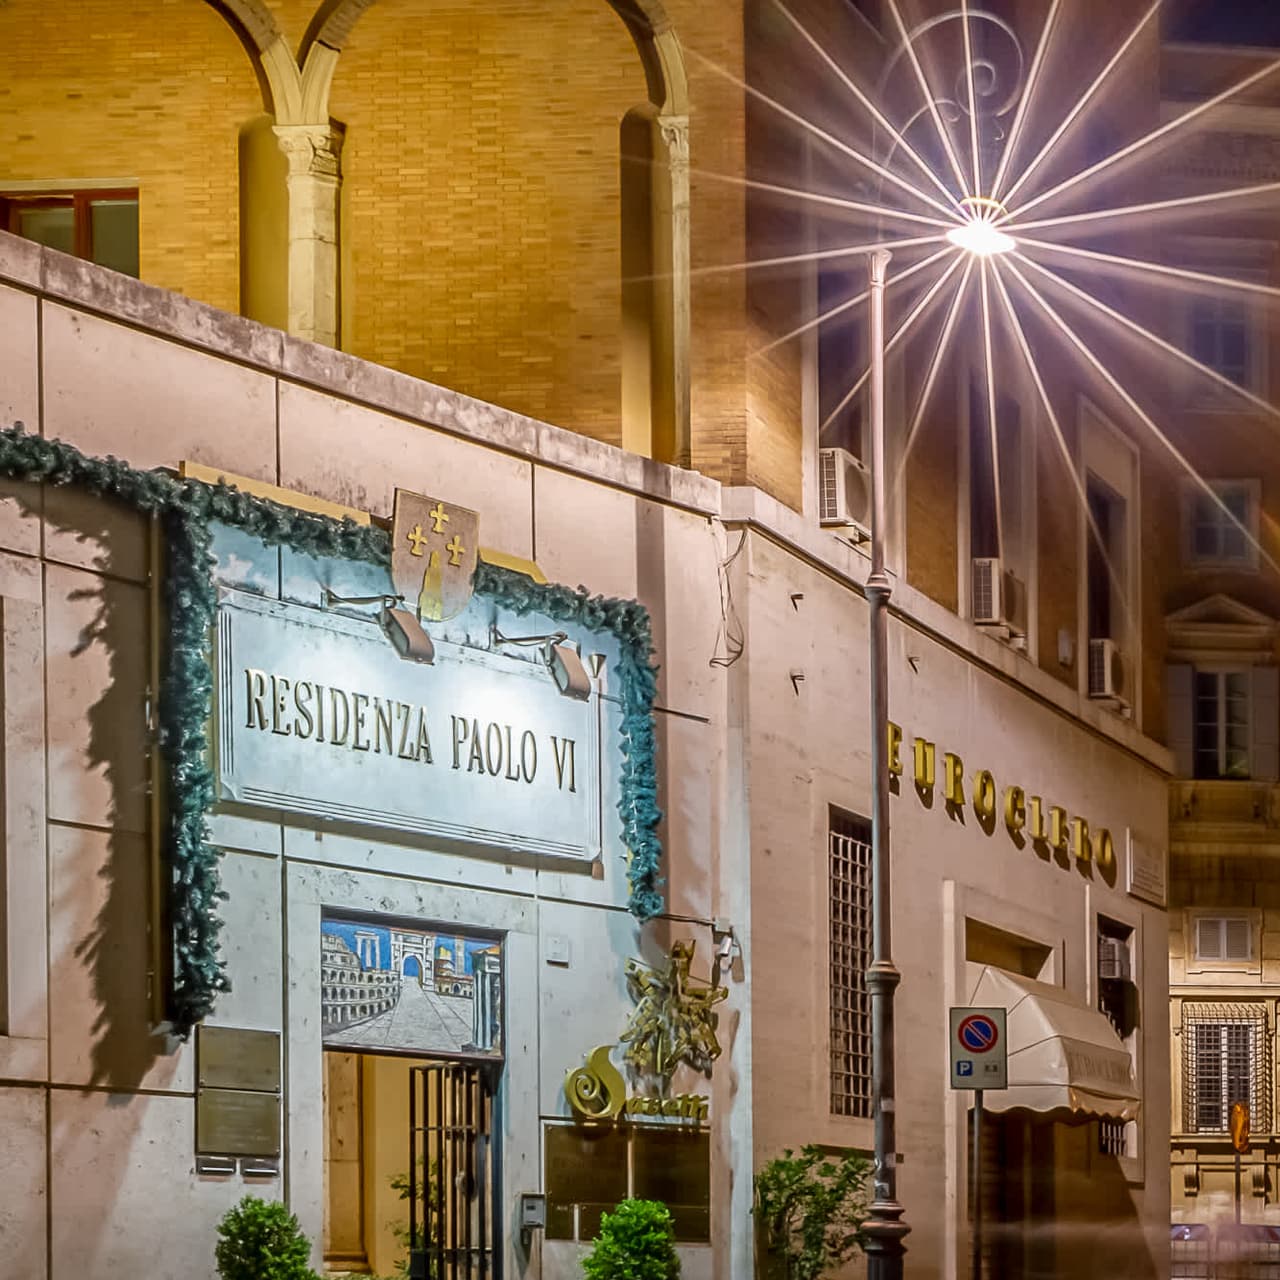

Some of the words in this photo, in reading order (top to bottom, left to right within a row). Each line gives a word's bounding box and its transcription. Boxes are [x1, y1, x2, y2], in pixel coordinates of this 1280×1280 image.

[244, 668, 434, 765] RESIDENZA
[450, 714, 538, 784] PAOLO
[550, 735, 577, 793] VI
[887, 719, 1112, 866] EUROCLERO
